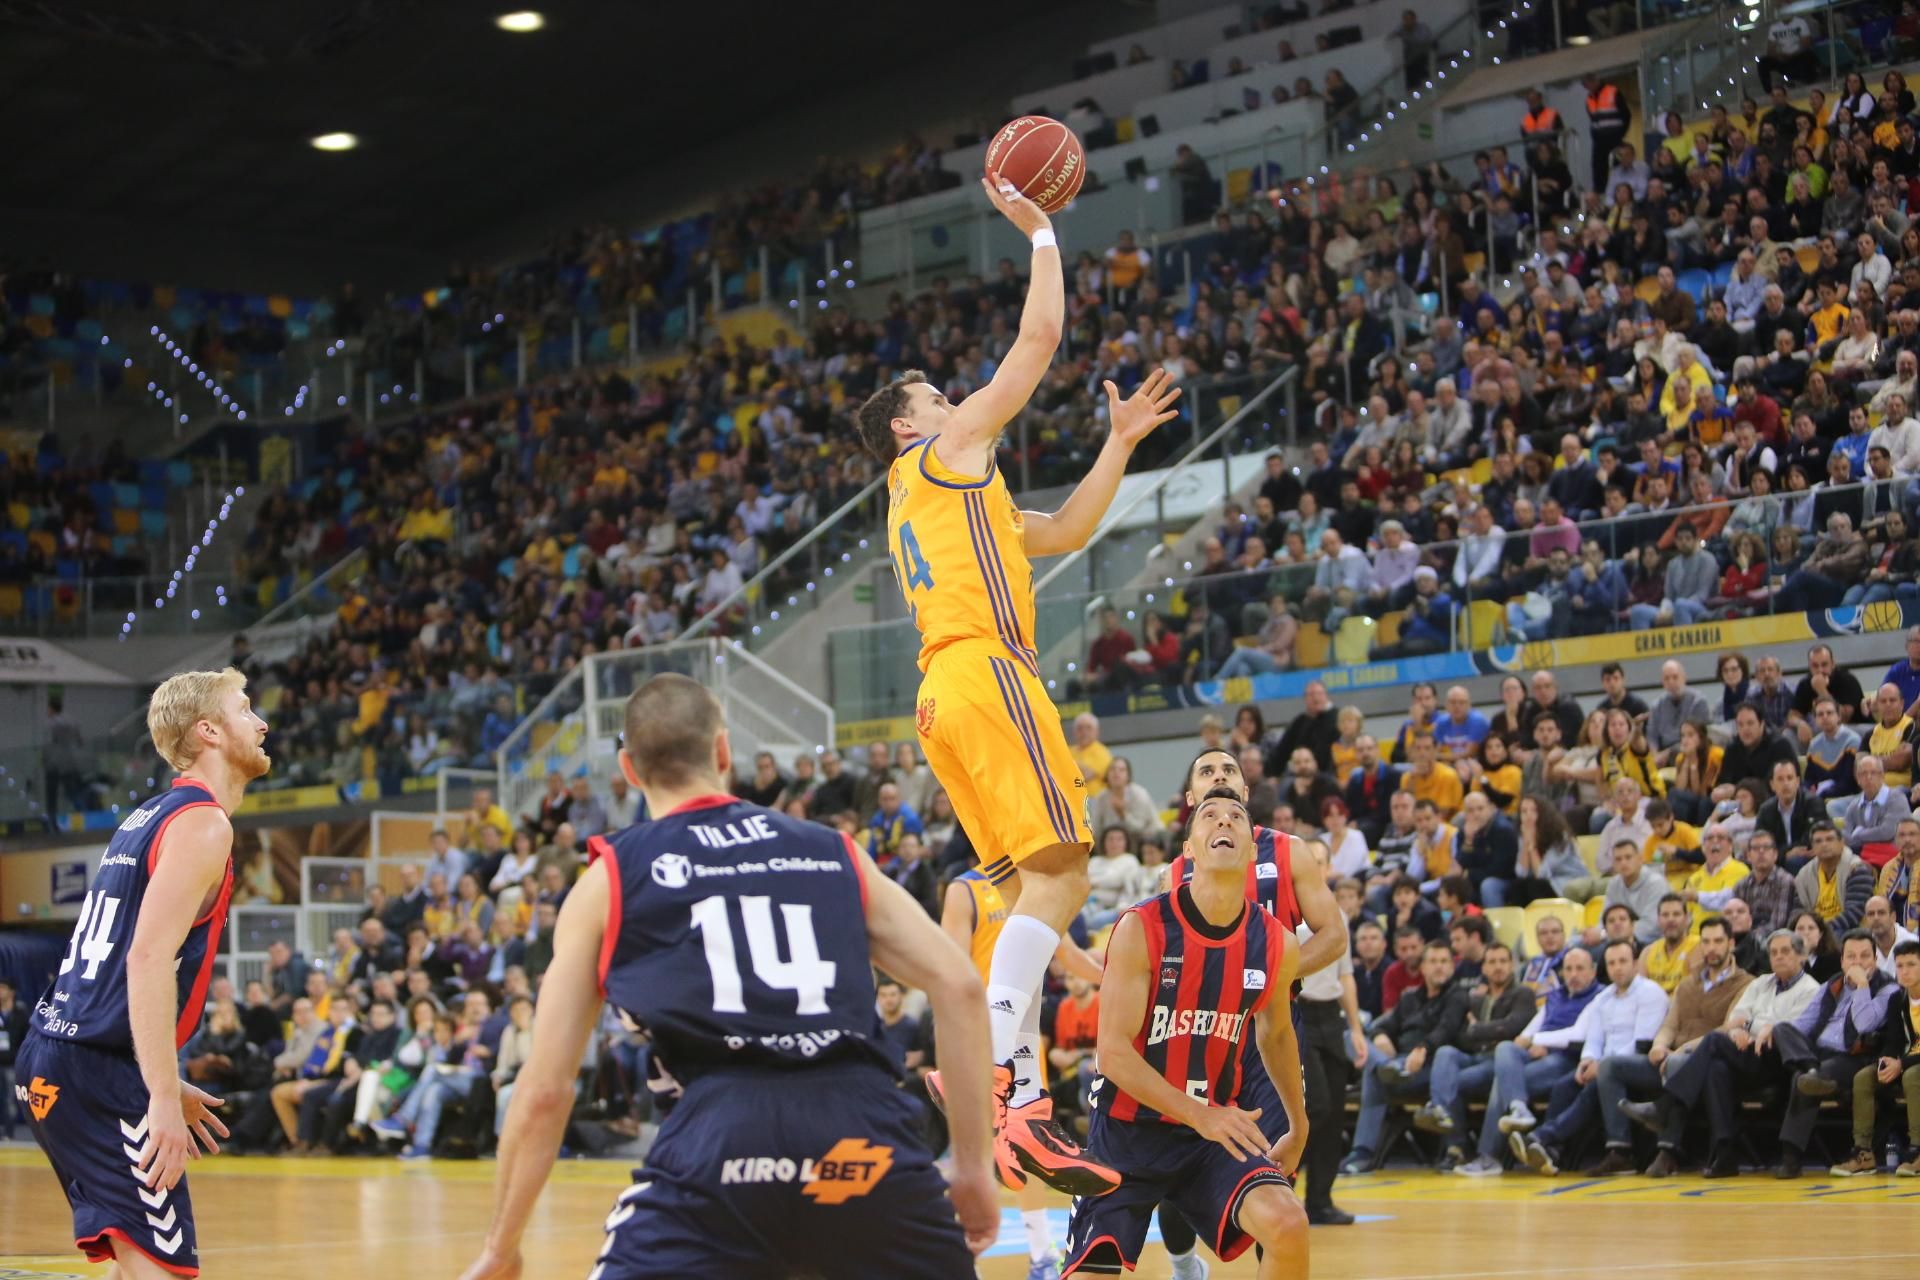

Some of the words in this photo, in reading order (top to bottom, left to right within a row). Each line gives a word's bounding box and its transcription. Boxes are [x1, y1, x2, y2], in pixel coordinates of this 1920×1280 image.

[1634, 630, 1666, 653] GRAN
[1670, 626, 1722, 648] CANARIA
[687, 814, 779, 849] TILLIE
[693, 863, 737, 878] Save
[736, 861, 768, 874] the
[767, 857, 843, 873] Children
[689, 895, 837, 1016] 14
[1147, 1004, 1250, 1046] BASKONI
[1012, 1053, 1035, 1061] adidas
